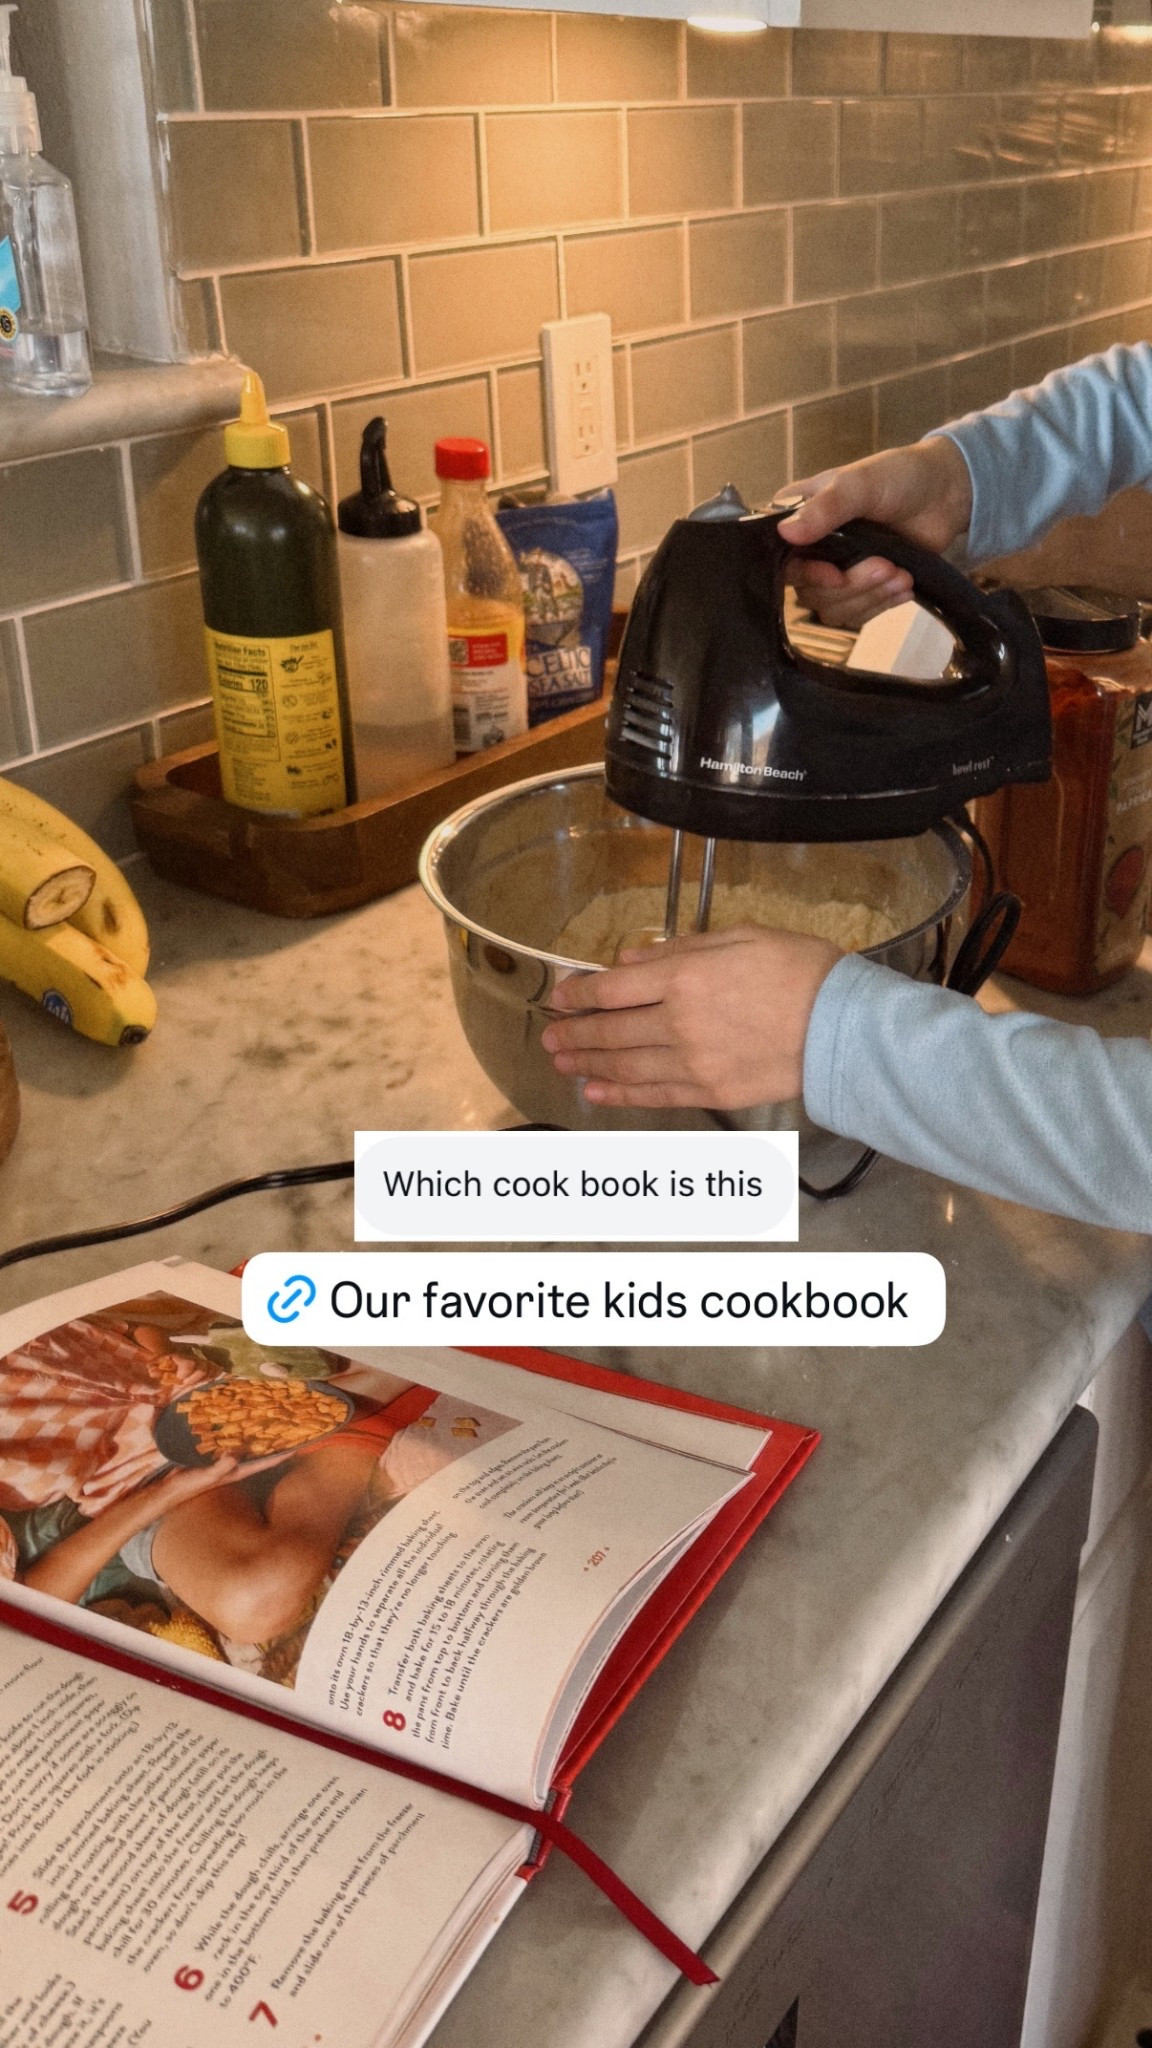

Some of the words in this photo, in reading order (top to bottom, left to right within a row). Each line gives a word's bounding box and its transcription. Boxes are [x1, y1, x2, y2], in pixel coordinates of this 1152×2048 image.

[526, 648, 590, 672] CELTIC
[250, 678, 269, 692] 120
[396, 1567, 406, 1579] all
[403, 1555, 417, 1568] the
[405, 1561, 428, 1586] longer
[481, 1554, 509, 1582] turning
[502, 1563, 515, 1579] the
[373, 1580, 398, 1618] separate
[400, 1588, 411, 1599] no
[471, 1582, 484, 1598] and
[479, 1579, 505, 1610] through
[443, 1599, 456, 1609] 18
[447, 1599, 474, 1632] bottom
[365, 1620, 375, 1631] to
[380, 1601, 403, 1634] they're
[388, 1653, 409, 1694] Transfer
[404, 1627, 422, 1651] both
[417, 1595, 444, 1626] baking
[438, 1569, 459, 1594] sheets
[456, 1560, 466, 1568] to
[462, 1548, 476, 1559] the
[429, 1624, 441, 1634] 15
[437, 1612, 448, 1622] to
[457, 1611, 485, 1647] halfway
[350, 1634, 370, 1664] hands
[370, 1637, 384, 1658] that
[420, 1637, 434, 1652] for
[442, 1634, 453, 1644] to
[445, 1694, 461, 1720] Bake
[457, 1666, 472, 1692] until
[467, 1648, 480, 1665] the
[478, 1609, 503, 1646] crackers
[500, 1594, 512, 1608] are
[510, 1566, 530, 1595] golden
[336, 1646, 348, 1667] own
[366, 1661, 374, 1672] so
[409, 1655, 426, 1679] bake
[433, 1647, 448, 1664] top
[445, 1650, 463, 1674] back
[346, 1666, 356, 1691] your
[421, 1667, 438, 1693] from
[441, 1676, 451, 1687] to
[340, 1692, 350, 1710] Use
[356, 1675, 370, 1716] crackers
[406, 1680, 416, 1702] and
[417, 1695, 428, 1721] pans
[430, 1690, 446, 1717] front
[383, 1710, 406, 1731] 8
[411, 1721, 421, 1738] the
[425, 1719, 437, 1743] from
[194, 1921, 222, 1951] While
[220, 1901, 236, 1919] the
[234, 1869, 260, 1900] dough
[280, 1808, 308, 1840] arrange
[307, 1792, 322, 1808] one
[213, 1935, 232, 1959] rack
[228, 1922, 242, 1934] in
[239, 1902, 256, 1920] the
[253, 1882, 271, 1900] top
[267, 1855, 289, 1881] third
[288, 1842, 298, 1856] of
[295, 1827, 312, 1843] the
[311, 1806, 330, 1826] oven
[329, 1789, 344, 1805] and
[6, 1890, 38, 1915] 5
[204, 1980, 221, 2001] one
[220, 1967, 231, 1978] in
[228, 1947, 244, 1965] the
[240, 1907, 273, 1946] bottom
[290, 1854, 311, 1876] then
[335, 1805, 350, 1819] the
[270, 1946, 305, 1989] Remove
[302, 1927, 318, 1944] the
[313, 1892, 346, 1925] baking
[340, 1865, 362, 1891] sheet
[357, 1842, 379, 1864] from
[376, 1827, 390, 1841] the
[290, 1974, 306, 1997] and
[304, 1950, 322, 1974] slide
[321, 1928, 337, 1949] one
[336, 1913, 345, 1927] of
[343, 1897, 359, 1914] the
[357, 1866, 381, 1896] pieces
[379, 1852, 389, 1865] of
[174, 1965, 204, 1990] 6
[249, 2000, 278, 2028] 7
